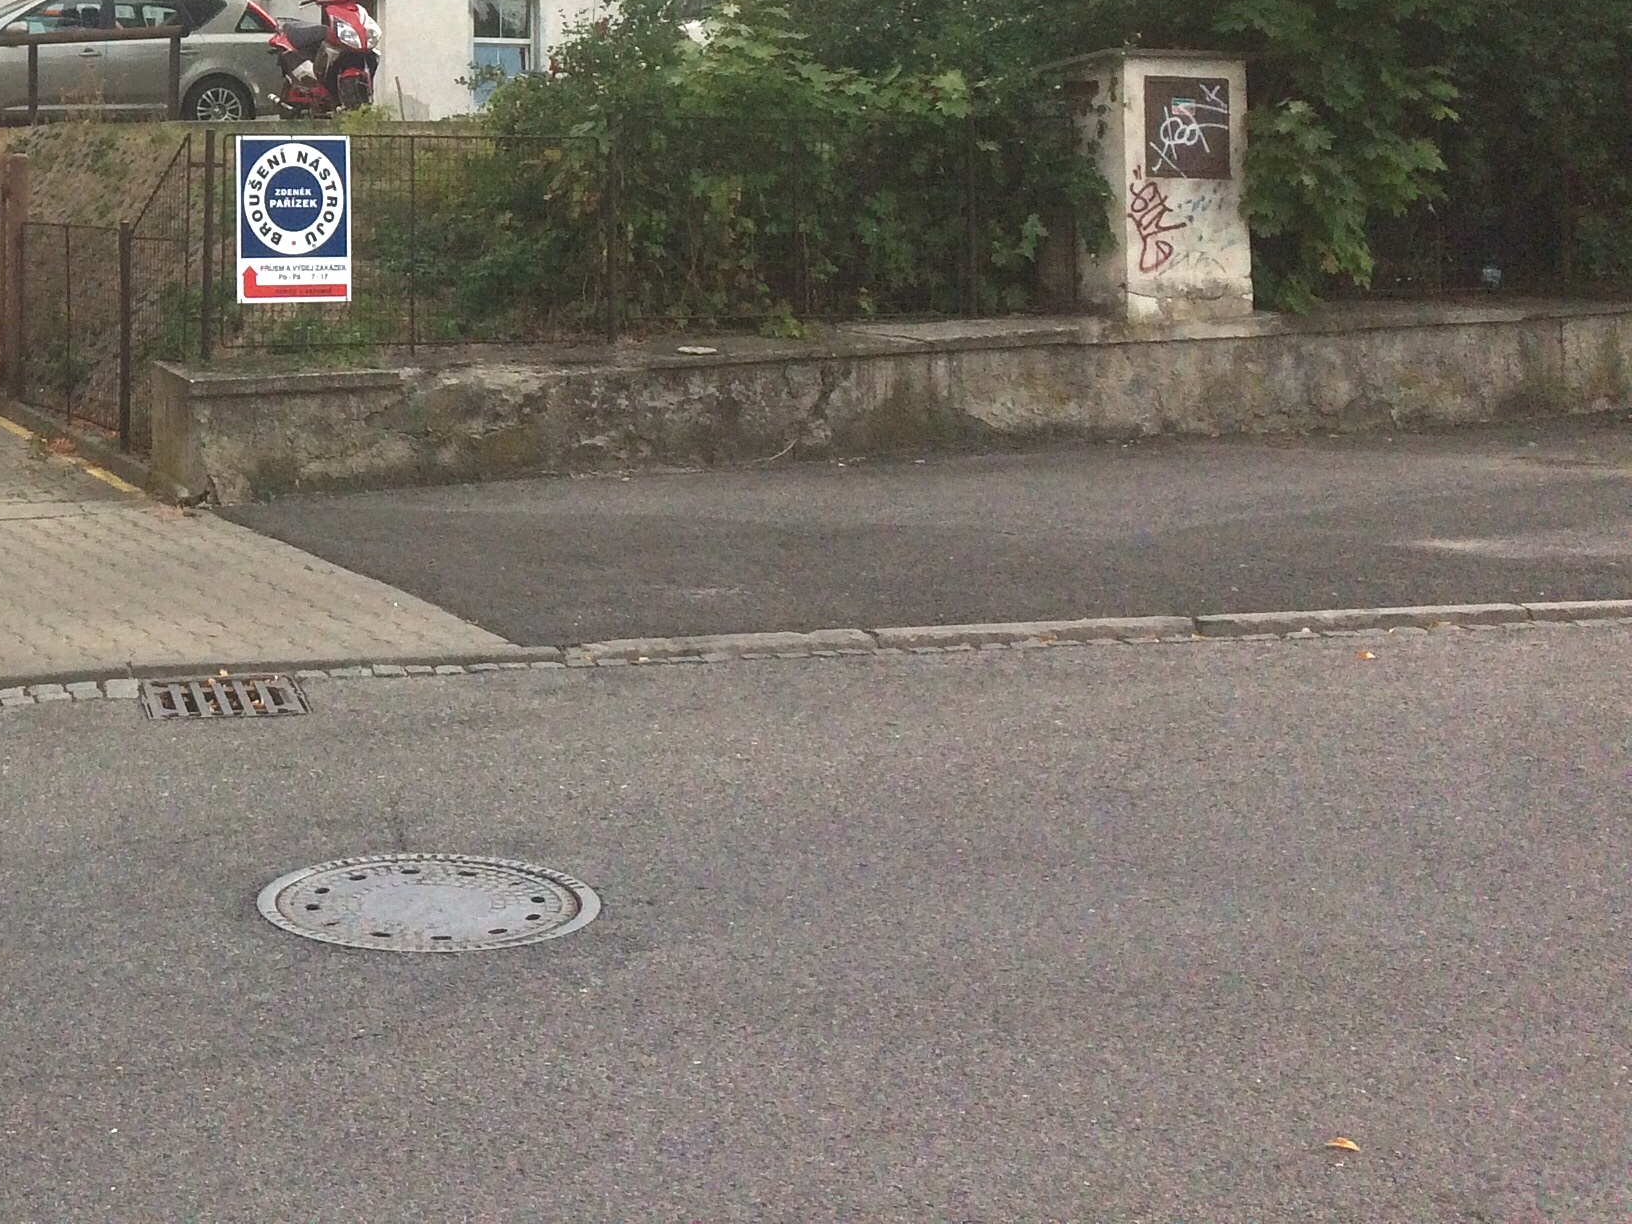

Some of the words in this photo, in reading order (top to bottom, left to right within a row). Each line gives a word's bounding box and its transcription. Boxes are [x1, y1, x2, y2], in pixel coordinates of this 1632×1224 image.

[274, 186, 312, 196] ZDENĚK
[248, 148, 287, 246] BROUŠENÍ
[296, 150, 338, 248] NÁSTROJŮ
[269, 196, 318, 208] PAŘÍZEK
